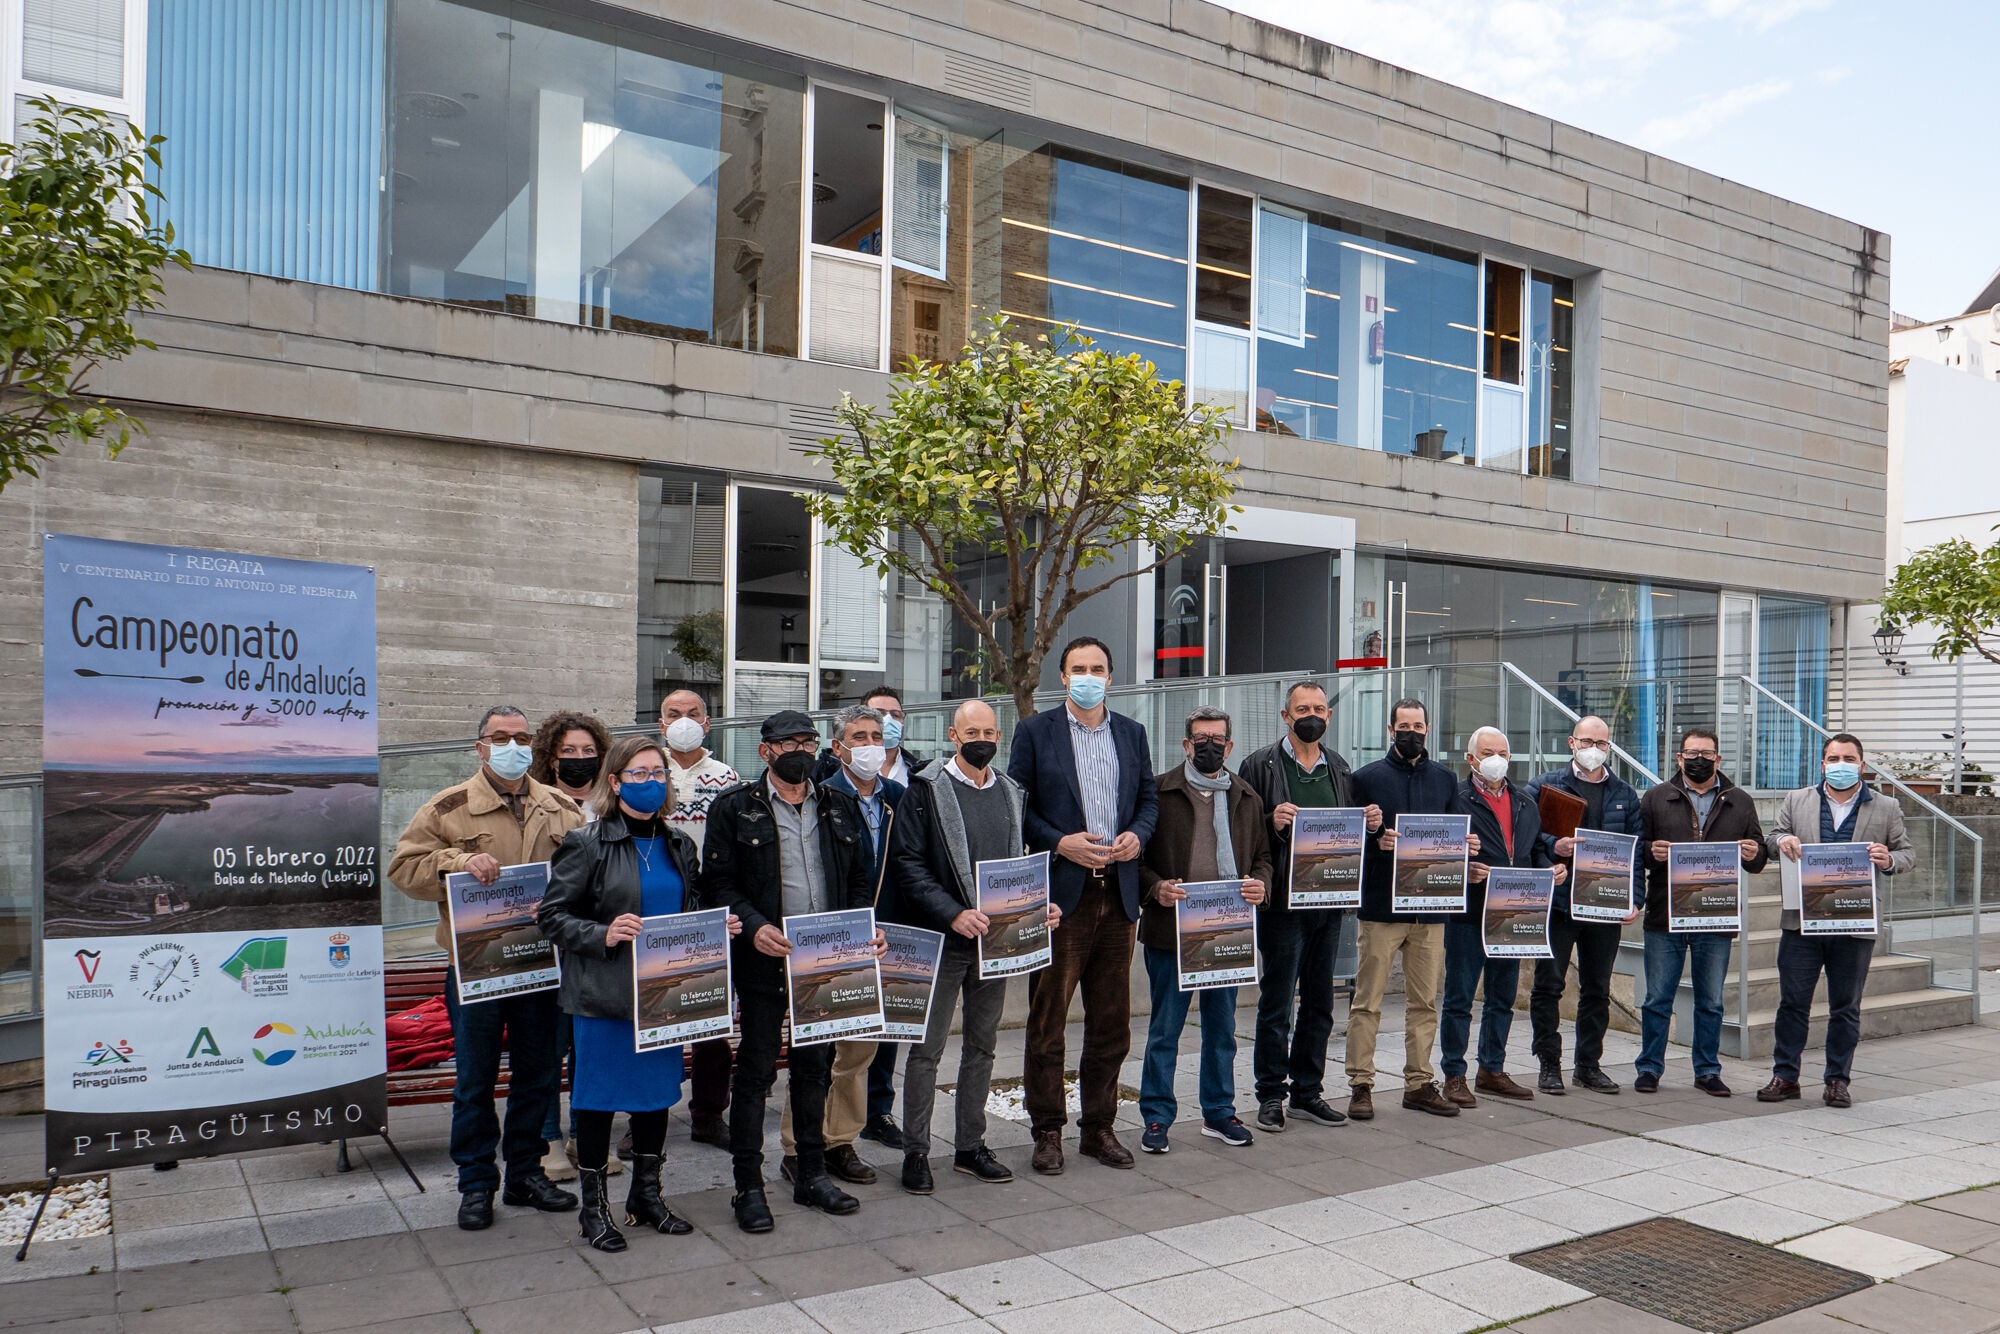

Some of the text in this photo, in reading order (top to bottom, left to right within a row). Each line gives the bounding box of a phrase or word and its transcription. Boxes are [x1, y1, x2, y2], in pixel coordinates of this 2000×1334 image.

[168, 553, 265, 576] I REGATA
[58, 563, 358, 600] V CENTENARIO ELIO ANTONIO DE NEBRIJA
[72, 596, 299, 668] Campeonato
[225, 660, 366, 697] de Andalucía
[154, 697, 240, 720] promoción
[241, 704, 260, 721] y
[266, 699, 316, 716] 3000
[213, 845, 375, 868] 05 Febrero 2022
[214, 868, 375, 889] Balsa de Melendo (Lebrija)
[988, 872, 1034, 891] Campeonato
[461, 885, 525, 905] Campeonato
[1186, 895, 1234, 911] Campeonato
[646, 931, 706, 951] Campeonato
[796, 929, 850, 949] Campeonato
[887, 942, 917, 955] eonato
[356, 969, 381, 978] Lebrija
[67, 988, 114, 999] NEBRIJA
[303, 1020, 376, 1041] Andalucía
[303, 1044, 327, 1052] Región
[303, 1050, 338, 1059] DEPORTE
[73, 1069, 112, 1078] Federación
[166, 1063, 190, 1071] Junta
[204, 1057, 244, 1067] Andalucía
[73, 1075, 148, 1089] Piragüismo
[74, 1103, 363, 1157] PIRAGÜISMO
